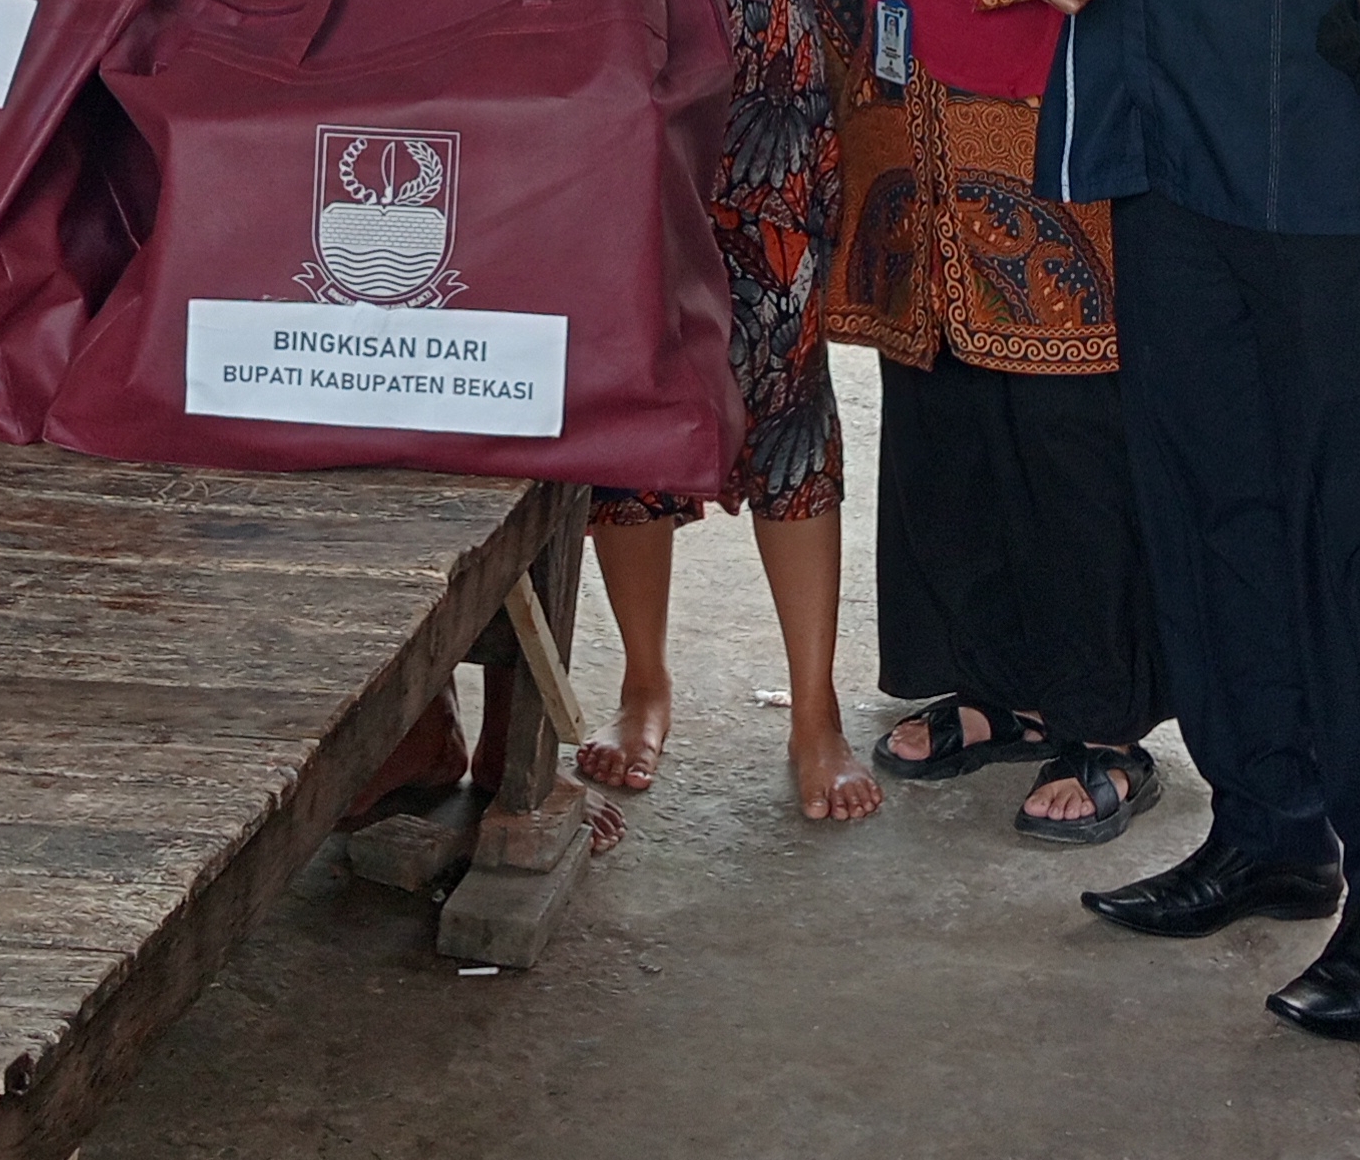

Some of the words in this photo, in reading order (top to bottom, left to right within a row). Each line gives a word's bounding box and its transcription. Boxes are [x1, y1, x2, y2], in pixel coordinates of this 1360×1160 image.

[273, 330, 417, 359] BINGKISAN
[425, 337, 488, 363] DARI
[222, 364, 303, 387] BUPATI
[309, 368, 446, 395] KABUPATEN
[452, 376, 535, 401] BEKASI
